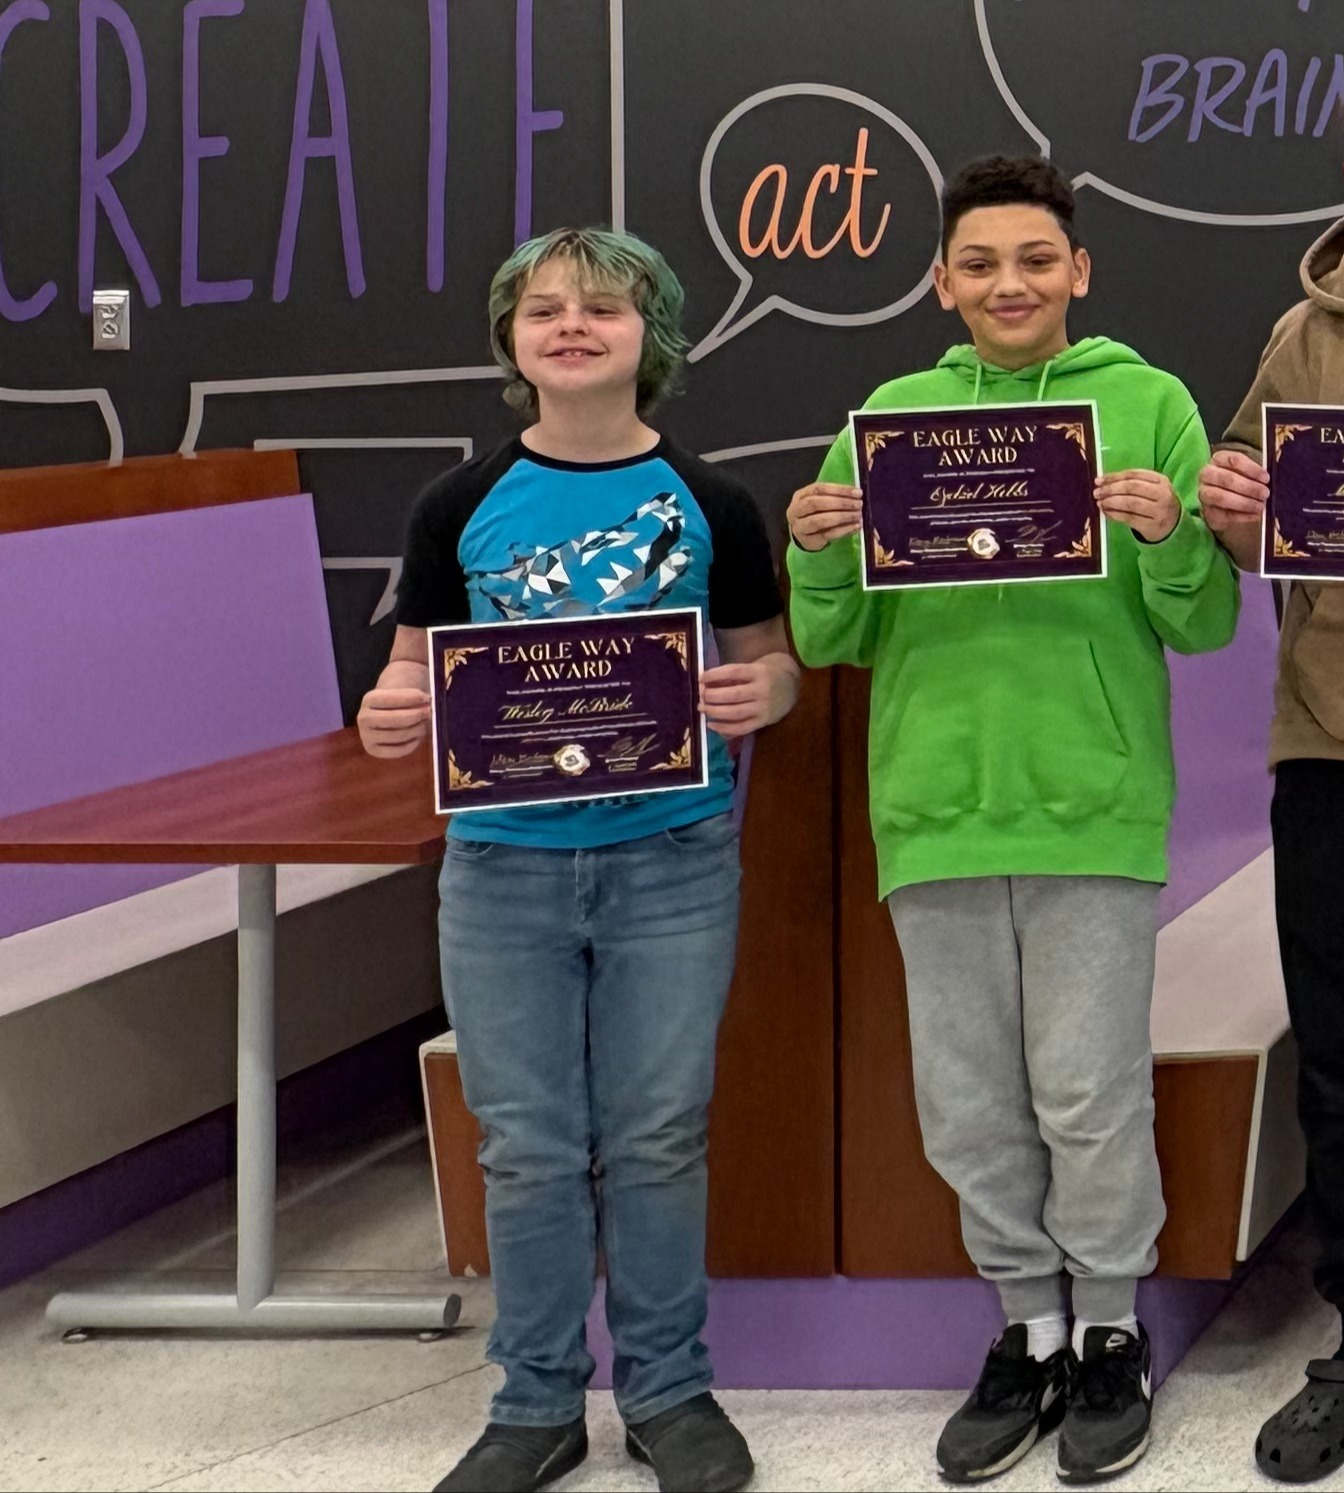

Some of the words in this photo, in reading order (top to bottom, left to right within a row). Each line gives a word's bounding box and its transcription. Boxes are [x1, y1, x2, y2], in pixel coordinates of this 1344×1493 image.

[739, 127, 892, 260] act
[913, 428, 980, 448] EAGLE
[988, 425, 1038, 443] WAY
[939, 447, 1017, 466] AWARD
[498, 641, 572, 664] EAGLE
[581, 637, 635, 656] WAY
[525, 660, 611, 683] AWARD
